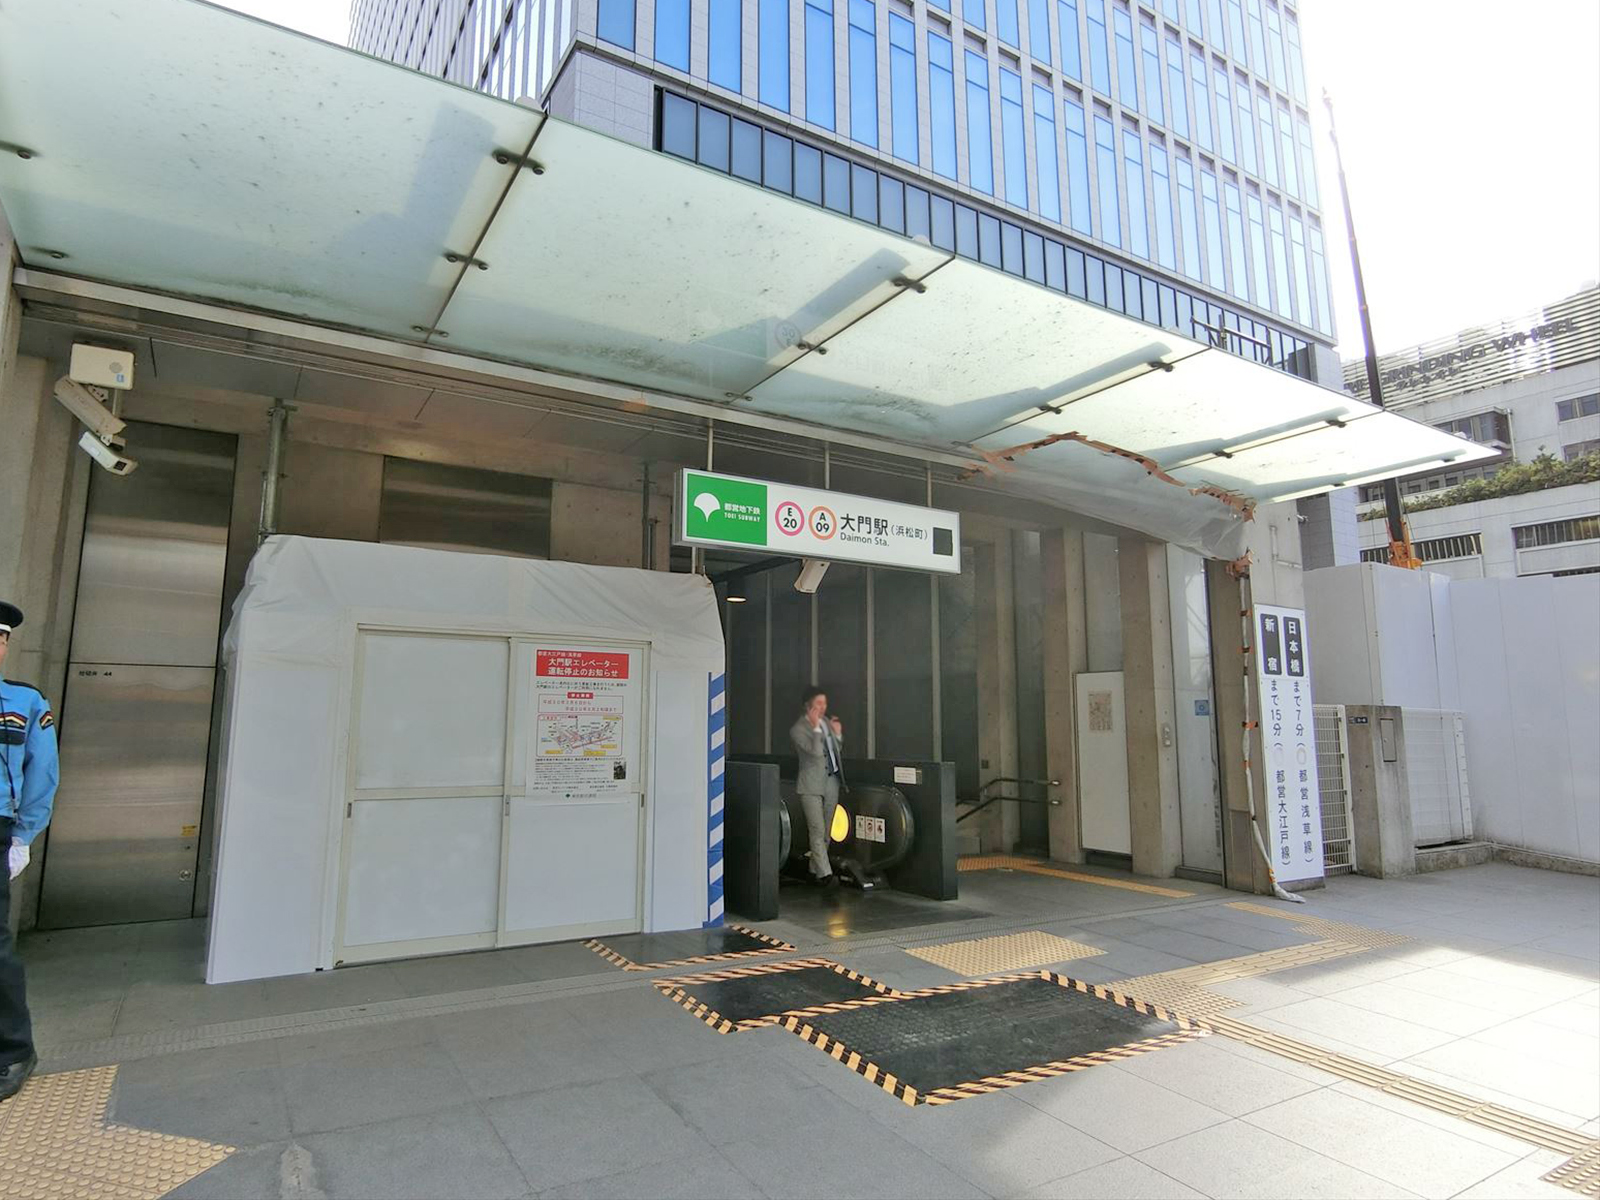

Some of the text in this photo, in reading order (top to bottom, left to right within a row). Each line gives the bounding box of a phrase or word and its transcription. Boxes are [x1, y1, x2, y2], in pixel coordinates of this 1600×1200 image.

[1491, 317, 1580, 352] WHEEL
[724, 503, 761, 515] 都営地下鉄
[787, 507, 793, 517] E
[738, 514, 761, 522] SUBWAY
[819, 512, 827, 522] A
[783, 517, 797, 529] 20
[816, 522, 830, 533] 09
[840, 532, 890, 547] Daimon Sta.
[548, 658, 619, 668] 大門駅エレベーター
[548, 666, 619, 678] 運転停止のお知らせ
